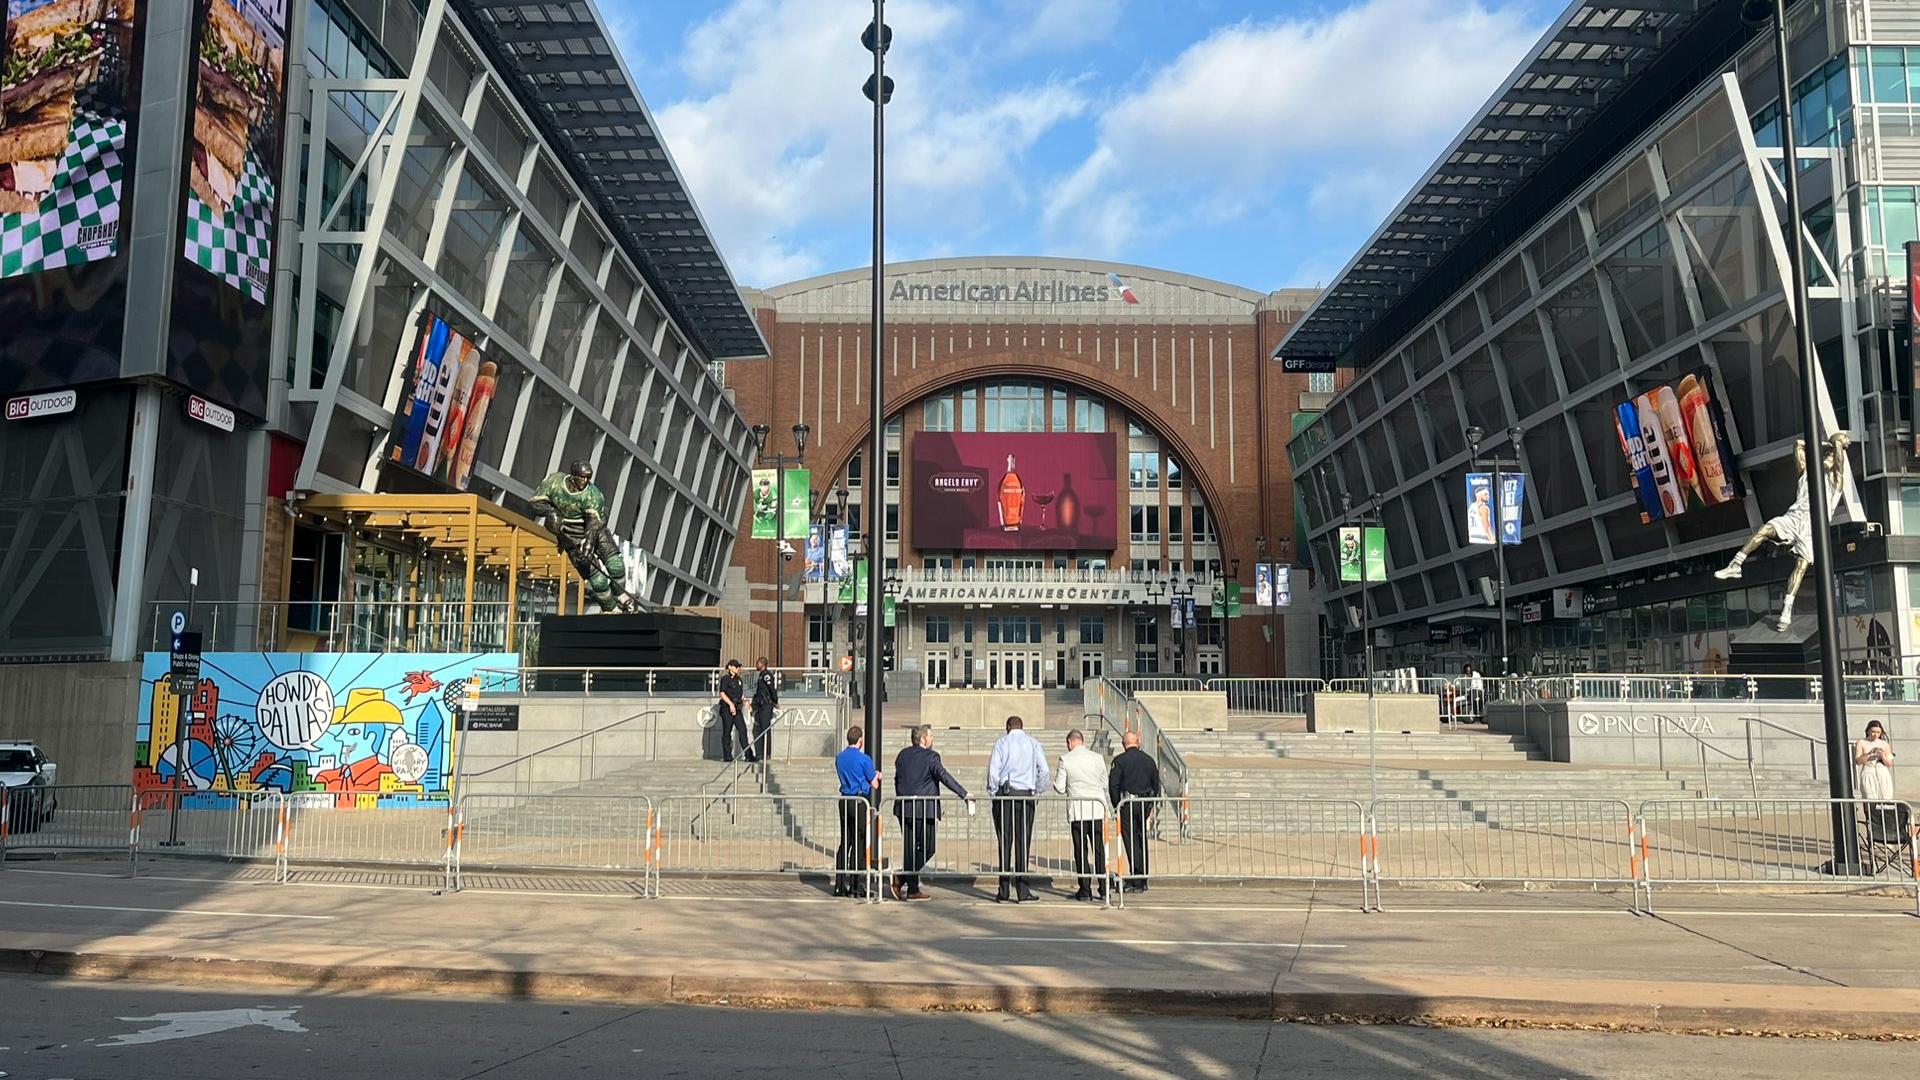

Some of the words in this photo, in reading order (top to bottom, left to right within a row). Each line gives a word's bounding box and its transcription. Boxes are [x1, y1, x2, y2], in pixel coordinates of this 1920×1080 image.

[77, 220, 118, 244] CHOPSHOP
[890, 280, 1010, 301] American
[1014, 280, 1109, 301] Airlines
[9, 399, 28, 416] BIG
[30, 396, 73, 411] OUTDOOR
[190, 399, 204, 416] BIG
[205, 407, 233, 426] OUTDOOR
[265, 674, 321, 705] HOWDY
[260, 690, 332, 747] DALLAS!
[1602, 715, 1648, 733] PNC
[1652, 715, 1715, 734] PLAZA
